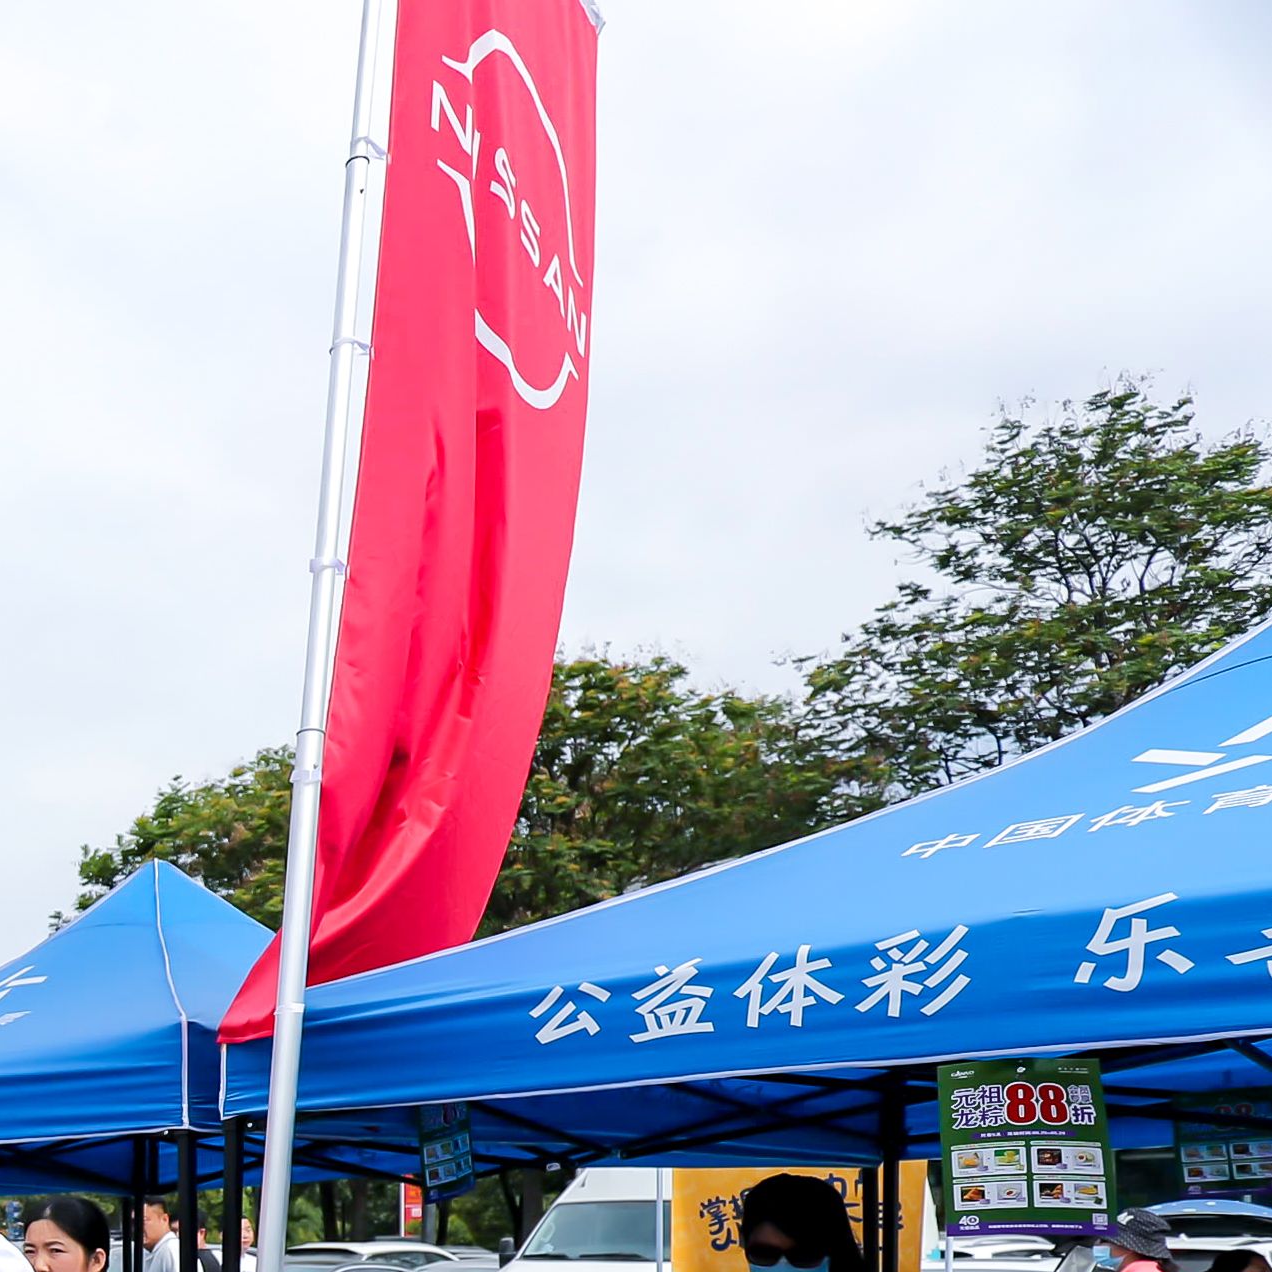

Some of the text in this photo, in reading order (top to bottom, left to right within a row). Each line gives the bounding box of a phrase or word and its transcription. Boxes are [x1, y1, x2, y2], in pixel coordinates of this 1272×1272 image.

[431, 79, 587, 358] NISSAN
[528, 924, 971, 1045] 公益体彩
[951, 1084, 1004, 1110] 元祖
[1004, 1081, 1070, 1126] 88
[952, 1106, 1006, 1130] 龙粽
[1071, 1105, 1096, 1126] 折
